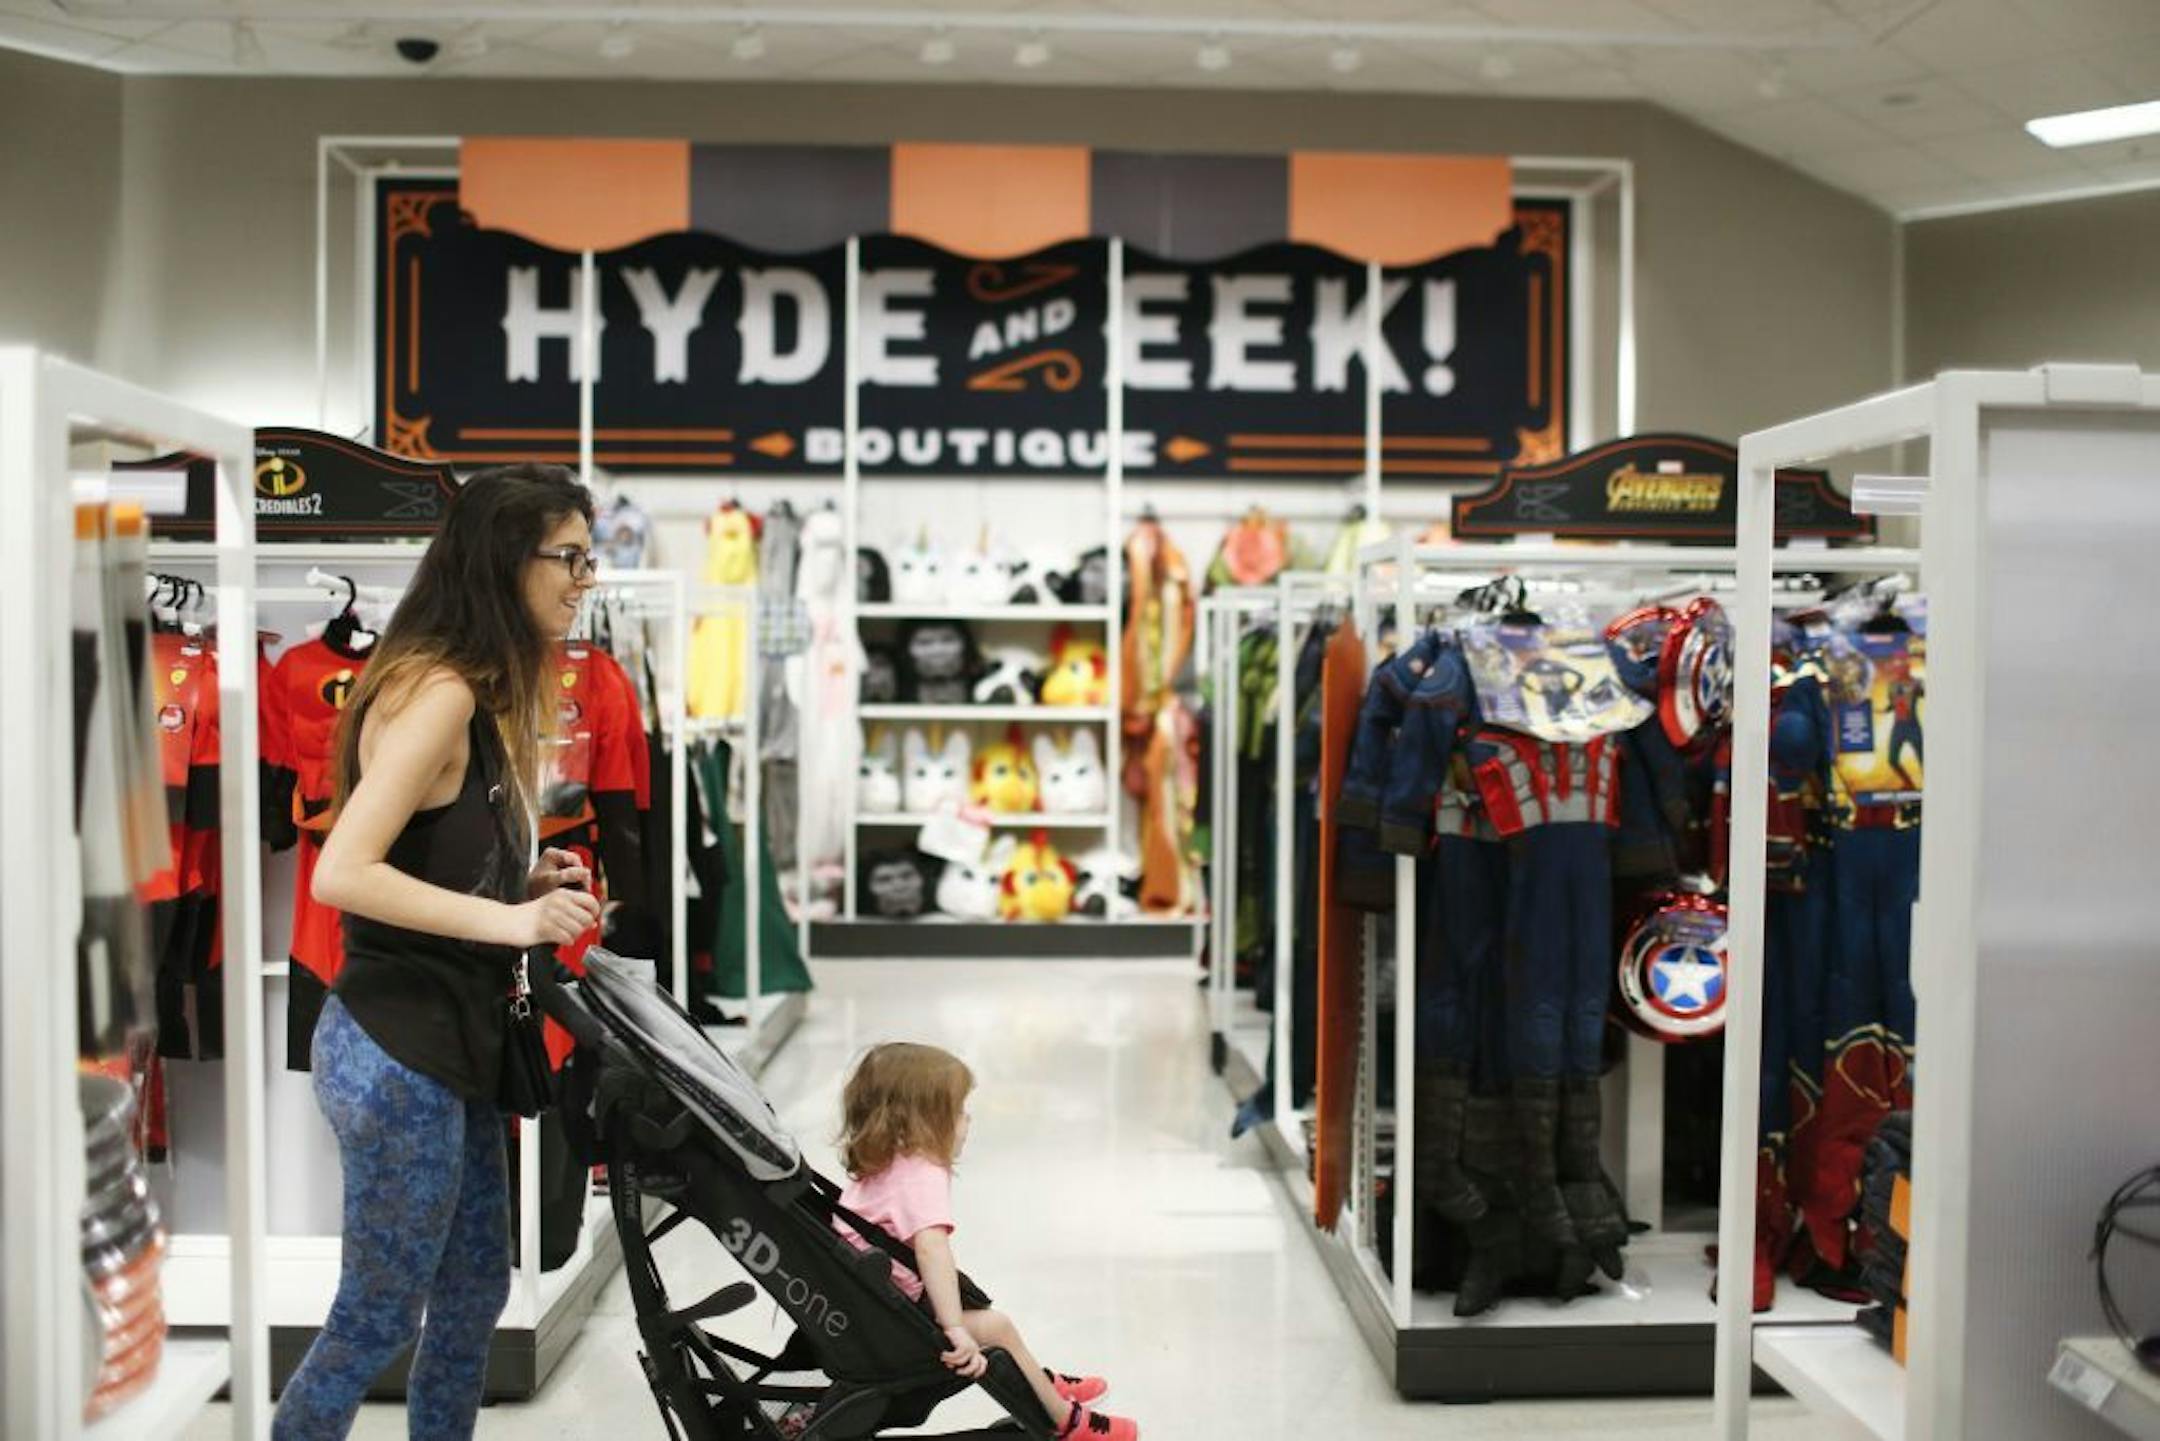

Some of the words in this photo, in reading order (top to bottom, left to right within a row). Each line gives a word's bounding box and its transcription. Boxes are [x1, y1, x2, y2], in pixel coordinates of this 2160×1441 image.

[501, 266, 938, 386] HYDE
[968, 298, 1078, 361] AND
[1102, 272, 1456, 397] EEK!
[804, 428, 1157, 467] BOUTIQUE
[720, 1216, 848, 1337] 3D-one
